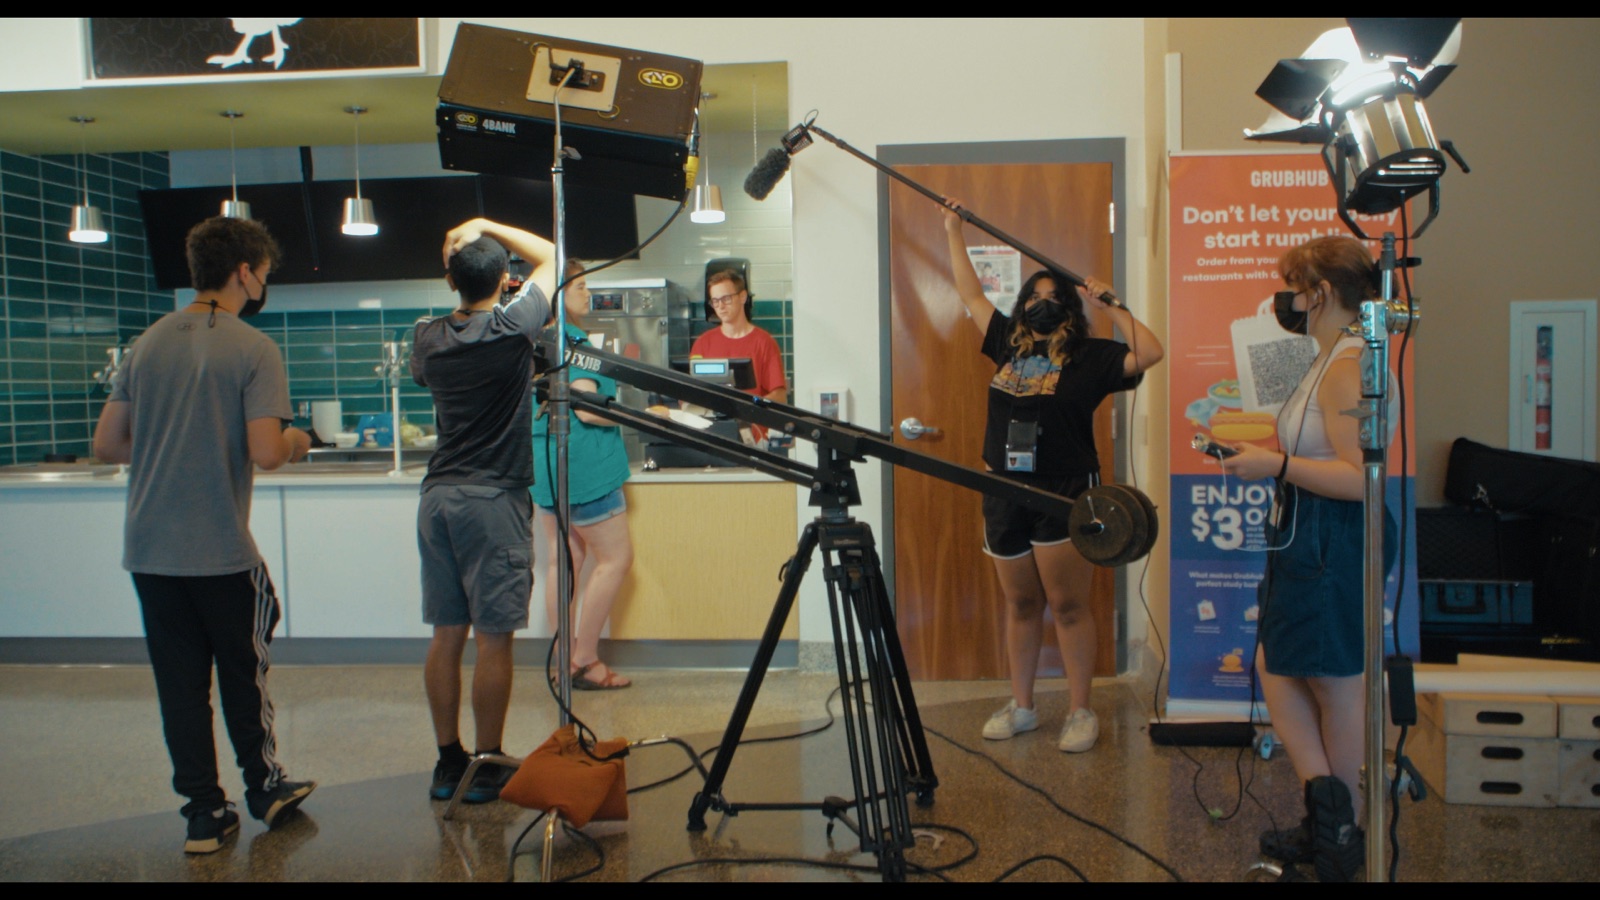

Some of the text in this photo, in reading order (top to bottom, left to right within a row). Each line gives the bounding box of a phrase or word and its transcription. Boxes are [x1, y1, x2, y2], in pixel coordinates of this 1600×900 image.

[482, 118, 516, 134] 4BANK
[1250, 170, 1329, 188] GRUBHUB
[1183, 205, 1244, 224] Don't
[1250, 204, 1280, 222] let
[1285, 207, 1338, 226] your
[1204, 230, 1260, 249] start
[1197, 257, 1227, 267] Order
[1230, 256, 1254, 265] from
[1183, 272, 1243, 282] restaurants
[1245, 270, 1268, 280] with
